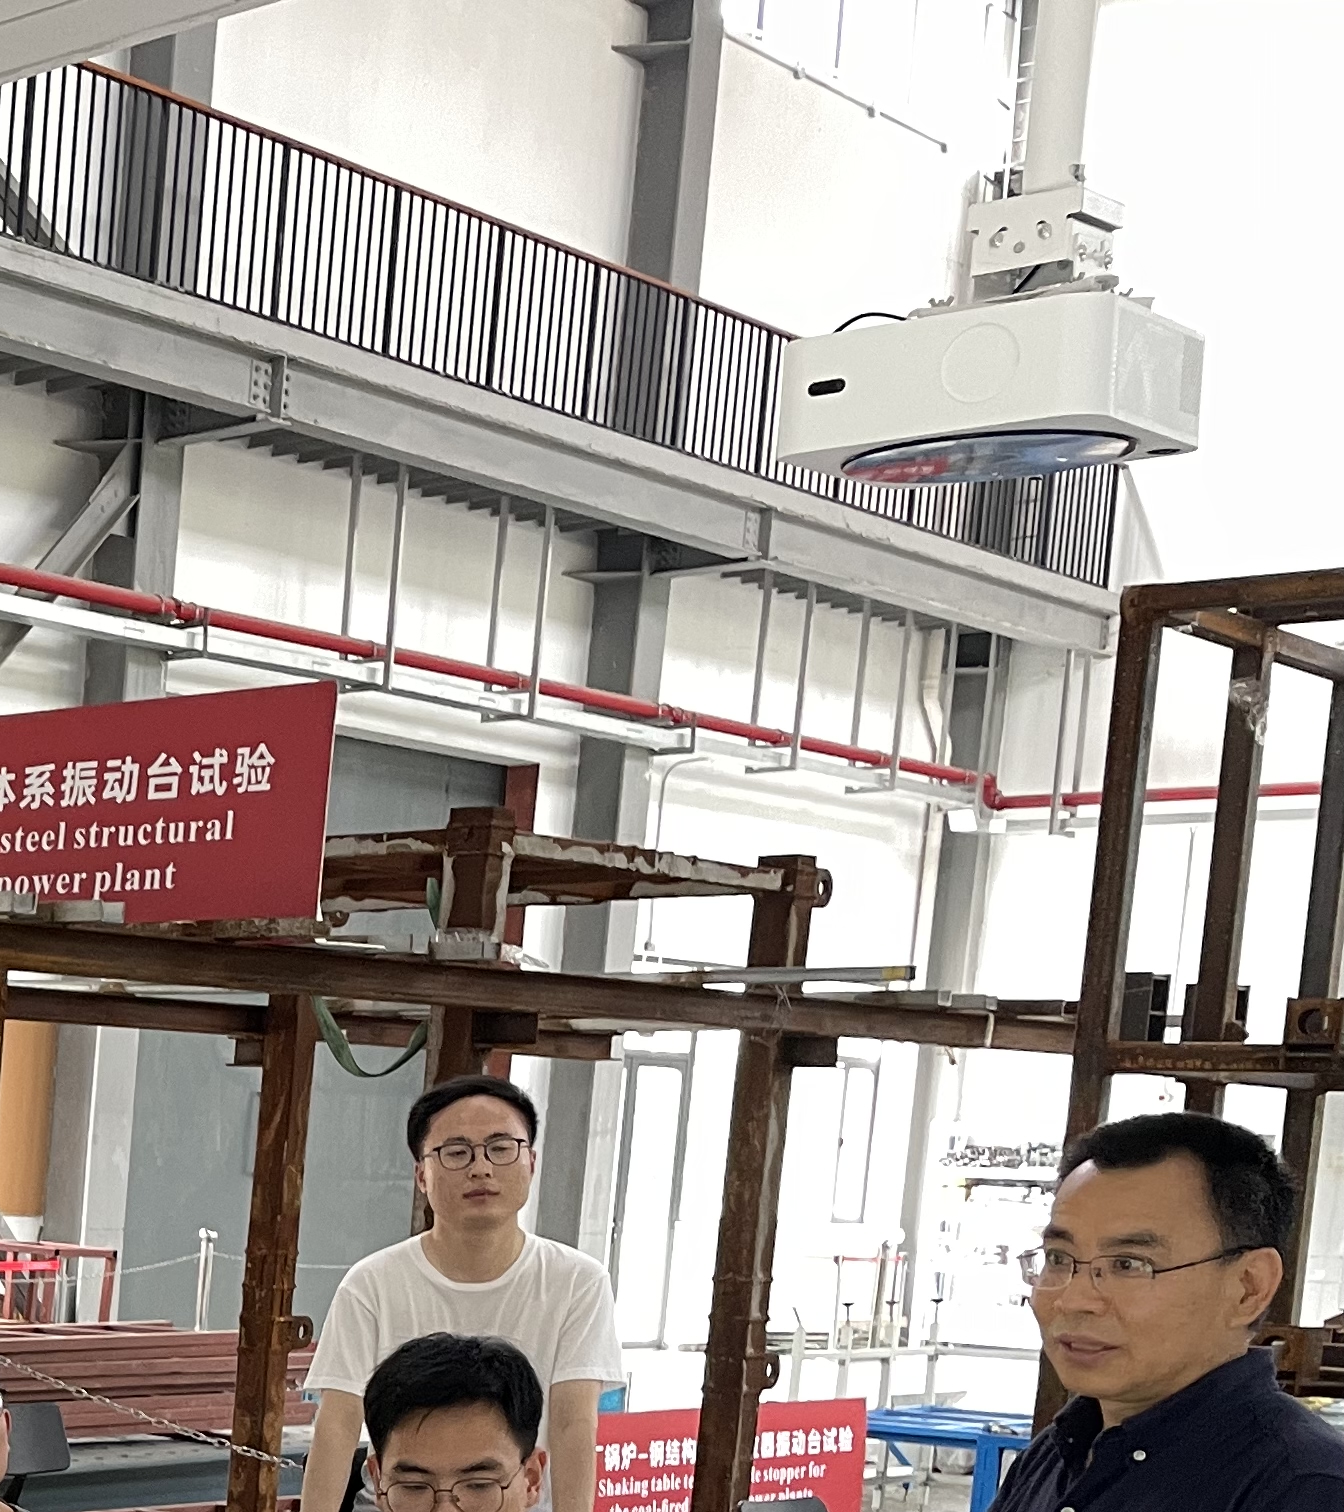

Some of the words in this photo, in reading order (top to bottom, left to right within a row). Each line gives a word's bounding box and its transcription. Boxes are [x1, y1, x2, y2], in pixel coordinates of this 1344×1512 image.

[0, 821, 66, 854] steel
[74, 810, 234, 849] structural
[93, 862, 176, 900] plant
[598, 1476, 648, 1498] Shaking
[651, 1473, 681, 1492] table
[763, 1465, 807, 1486] stopper
[809, 1460, 827, 1478] for
